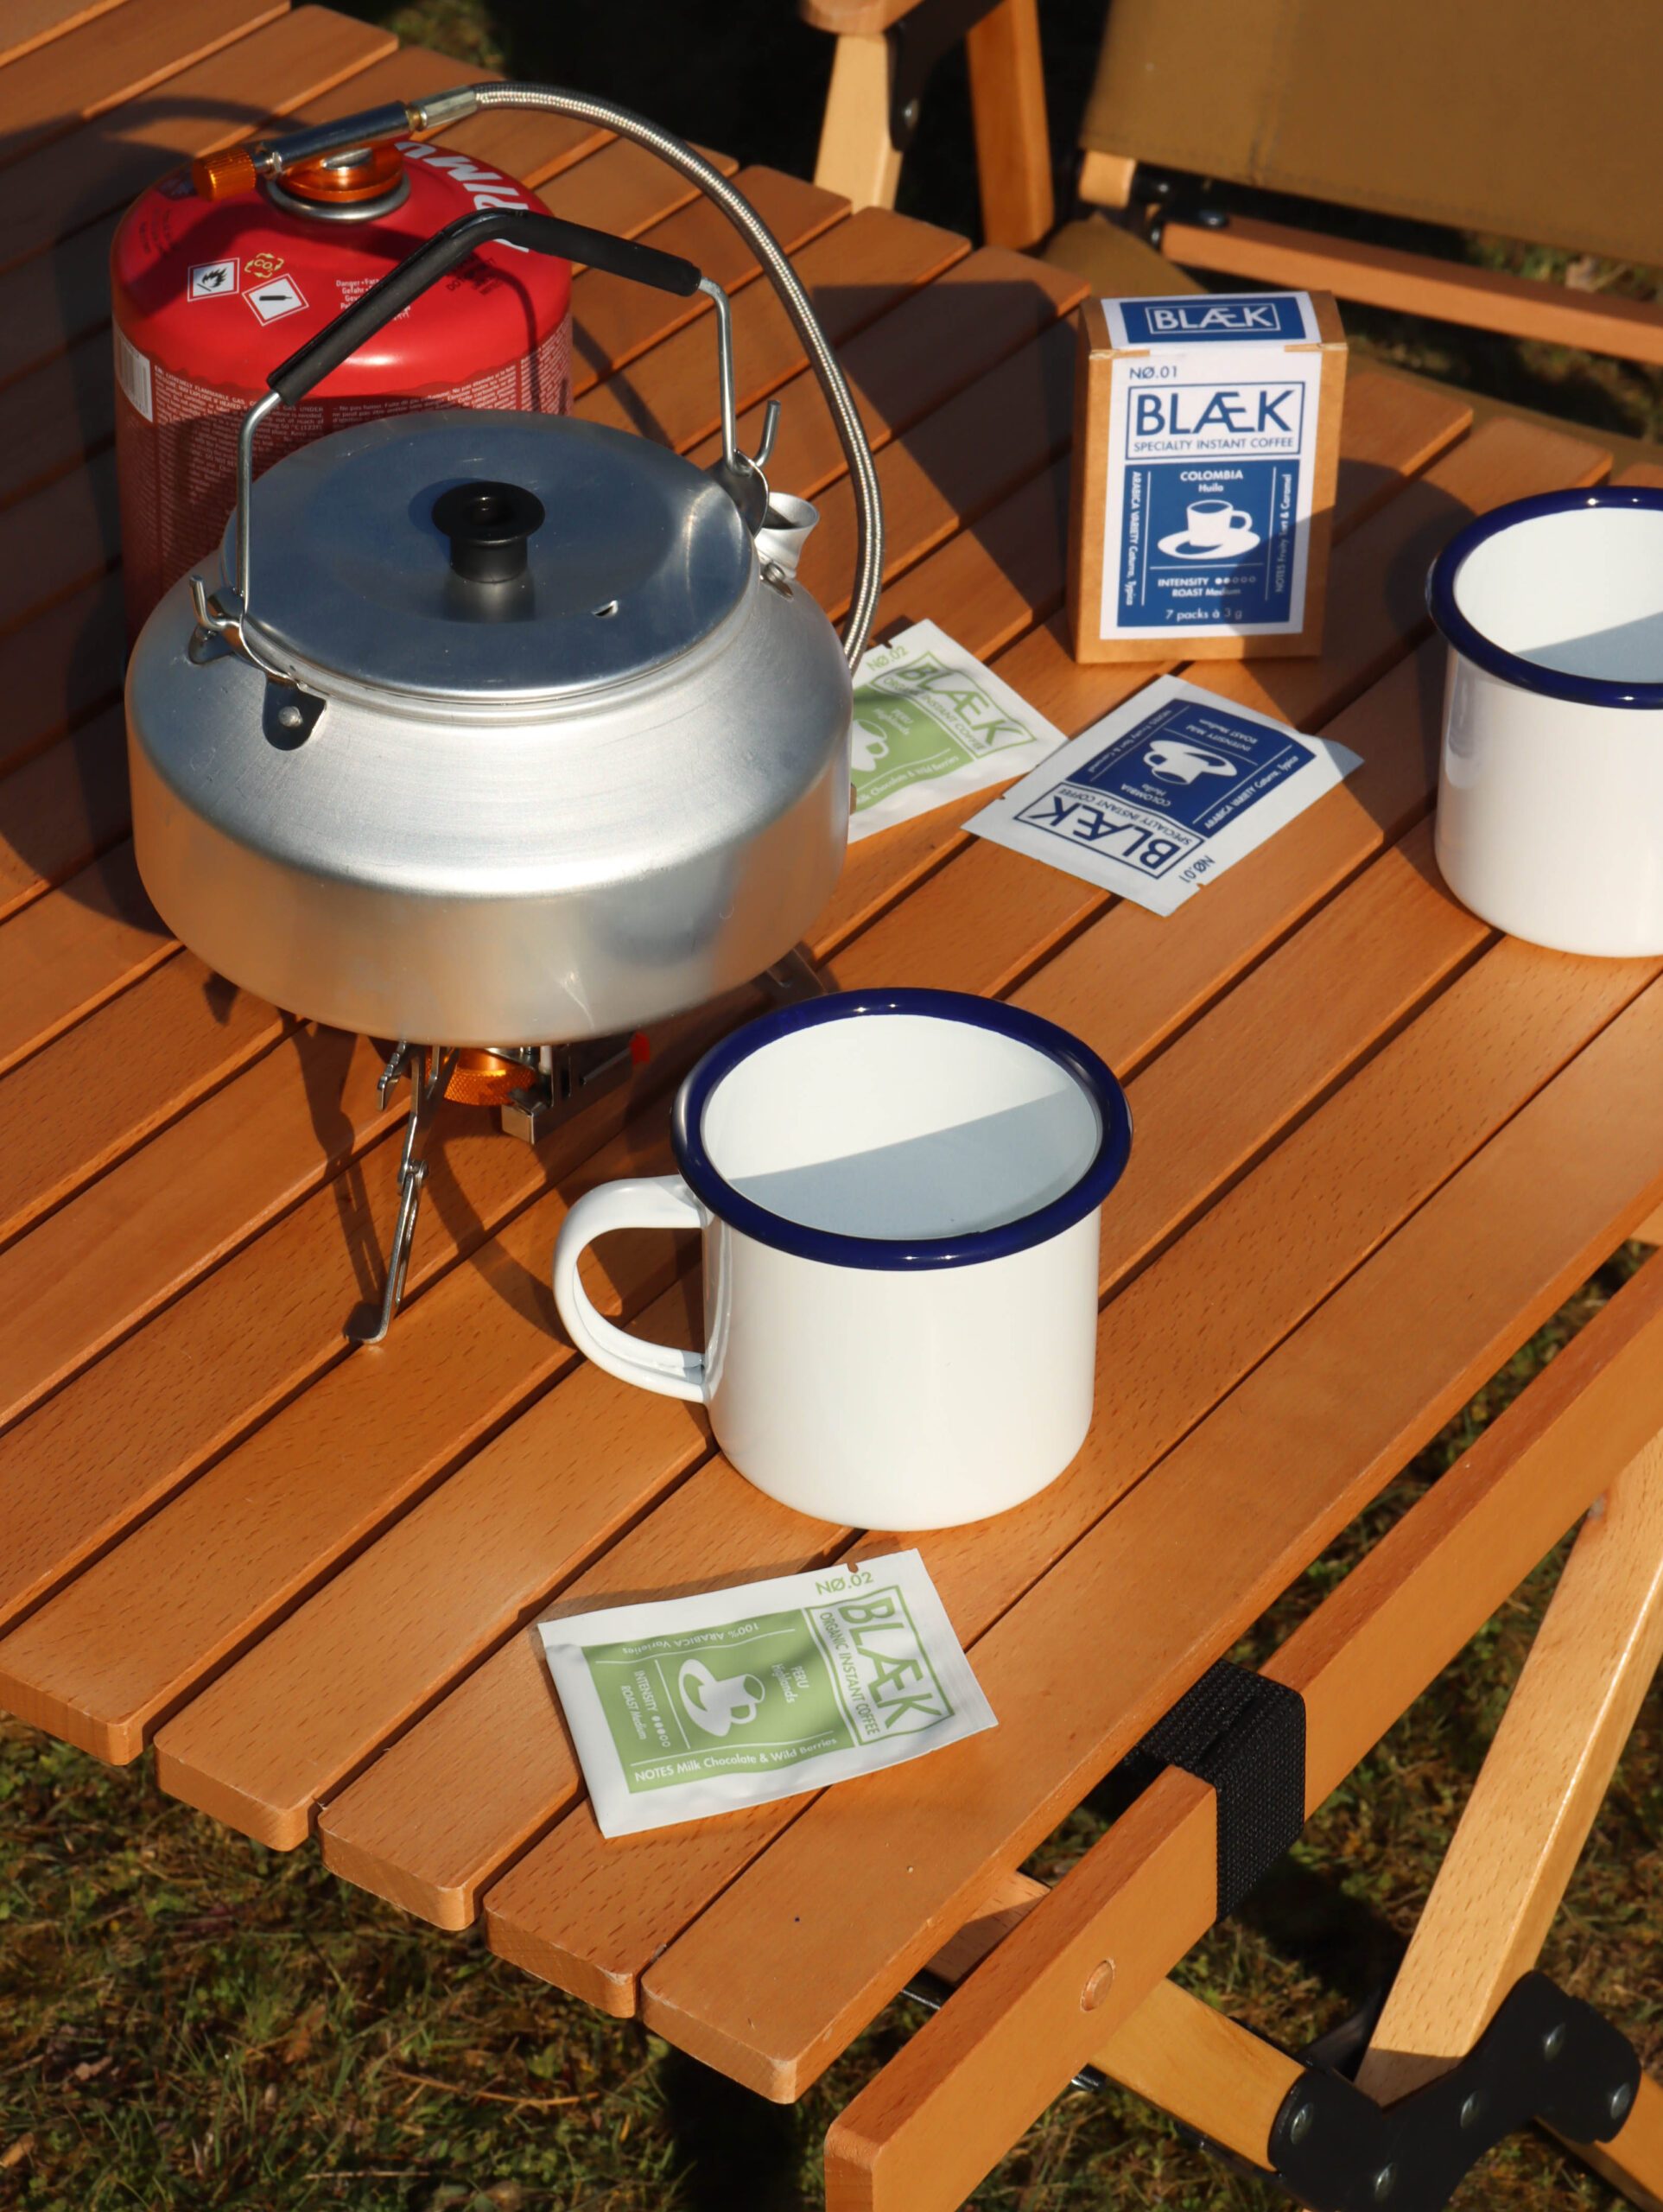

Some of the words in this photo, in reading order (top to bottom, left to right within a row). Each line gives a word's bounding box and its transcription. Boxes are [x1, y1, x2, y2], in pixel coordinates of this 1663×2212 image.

[395, 142, 530, 253] RIMU
[1153, 306, 1274, 330] BLÆK
[1129, 365, 1177, 379] NØ.01
[1136, 390, 1295, 436] BLÆK
[1133, 440, 1192, 452] SPECIALTY
[1196, 438, 1247, 449] INSTANT
[1250, 436, 1294, 448] COFFEE
[1179, 470, 1244, 481] COLOMBIA
[1131, 471, 1141, 510] ARABICA
[1280, 474, 1292, 510] Caramel
[1280, 511, 1290, 519] &
[1129, 512, 1140, 544] VARIETY
[1158, 577, 1209, 588] INTENSITY
[1274, 564, 1285, 594] NOTES
[1124, 581, 1136, 606] Typica
[1171, 588, 1203, 599] ROAST
[1205, 588, 1241, 597] Medium
[1165, 609, 1175, 620] 7
[1177, 608, 1209, 622] packs
[1212, 608, 1221, 620] à
[1225, 607, 1232, 618] 3
[1235, 610, 1243, 621] g
[895, 663, 1025, 745] BLÆK
[954, 722, 987, 751] COFFEE
[1207, 732, 1252, 752] INTENSITY
[1059, 788, 1096, 803] COFFEE
[1120, 783, 1171, 807] COLOMBIA
[1098, 799, 1142, 820] INSTANT
[1204, 805, 1234, 830] ARABICA
[1229, 785, 1256, 807] VARIETY
[1028, 796, 1181, 869] BLÆK
[1142, 817, 1192, 845] SPECIALTY
[815, 1572, 874, 1595] NØ.02
[673, 1631, 725, 1648] ARABICA
[727, 1622, 759, 1639] 100%
[622, 1639, 671, 1655] Varieties
[819, 1611, 849, 1650] ORGANIC
[838, 1651, 866, 1702] INSTANT
[854, 1701, 881, 1736] COFFEE
[838, 1596, 942, 1729] BLÆK
[790, 1665, 809, 1688] PERU
[634, 1669, 659, 1712] INTENSITY
[620, 1685, 639, 1711] ROAST
[630, 1711, 648, 1740] Medium
[634, 1764, 675, 1782] NOTES
[676, 1760, 701, 1775] Milk
[703, 1751, 757, 1769] Chocolate
[759, 1752, 770, 1764] &
[771, 1745, 797, 1762] Wild
[798, 1737, 837, 1755] Berries
